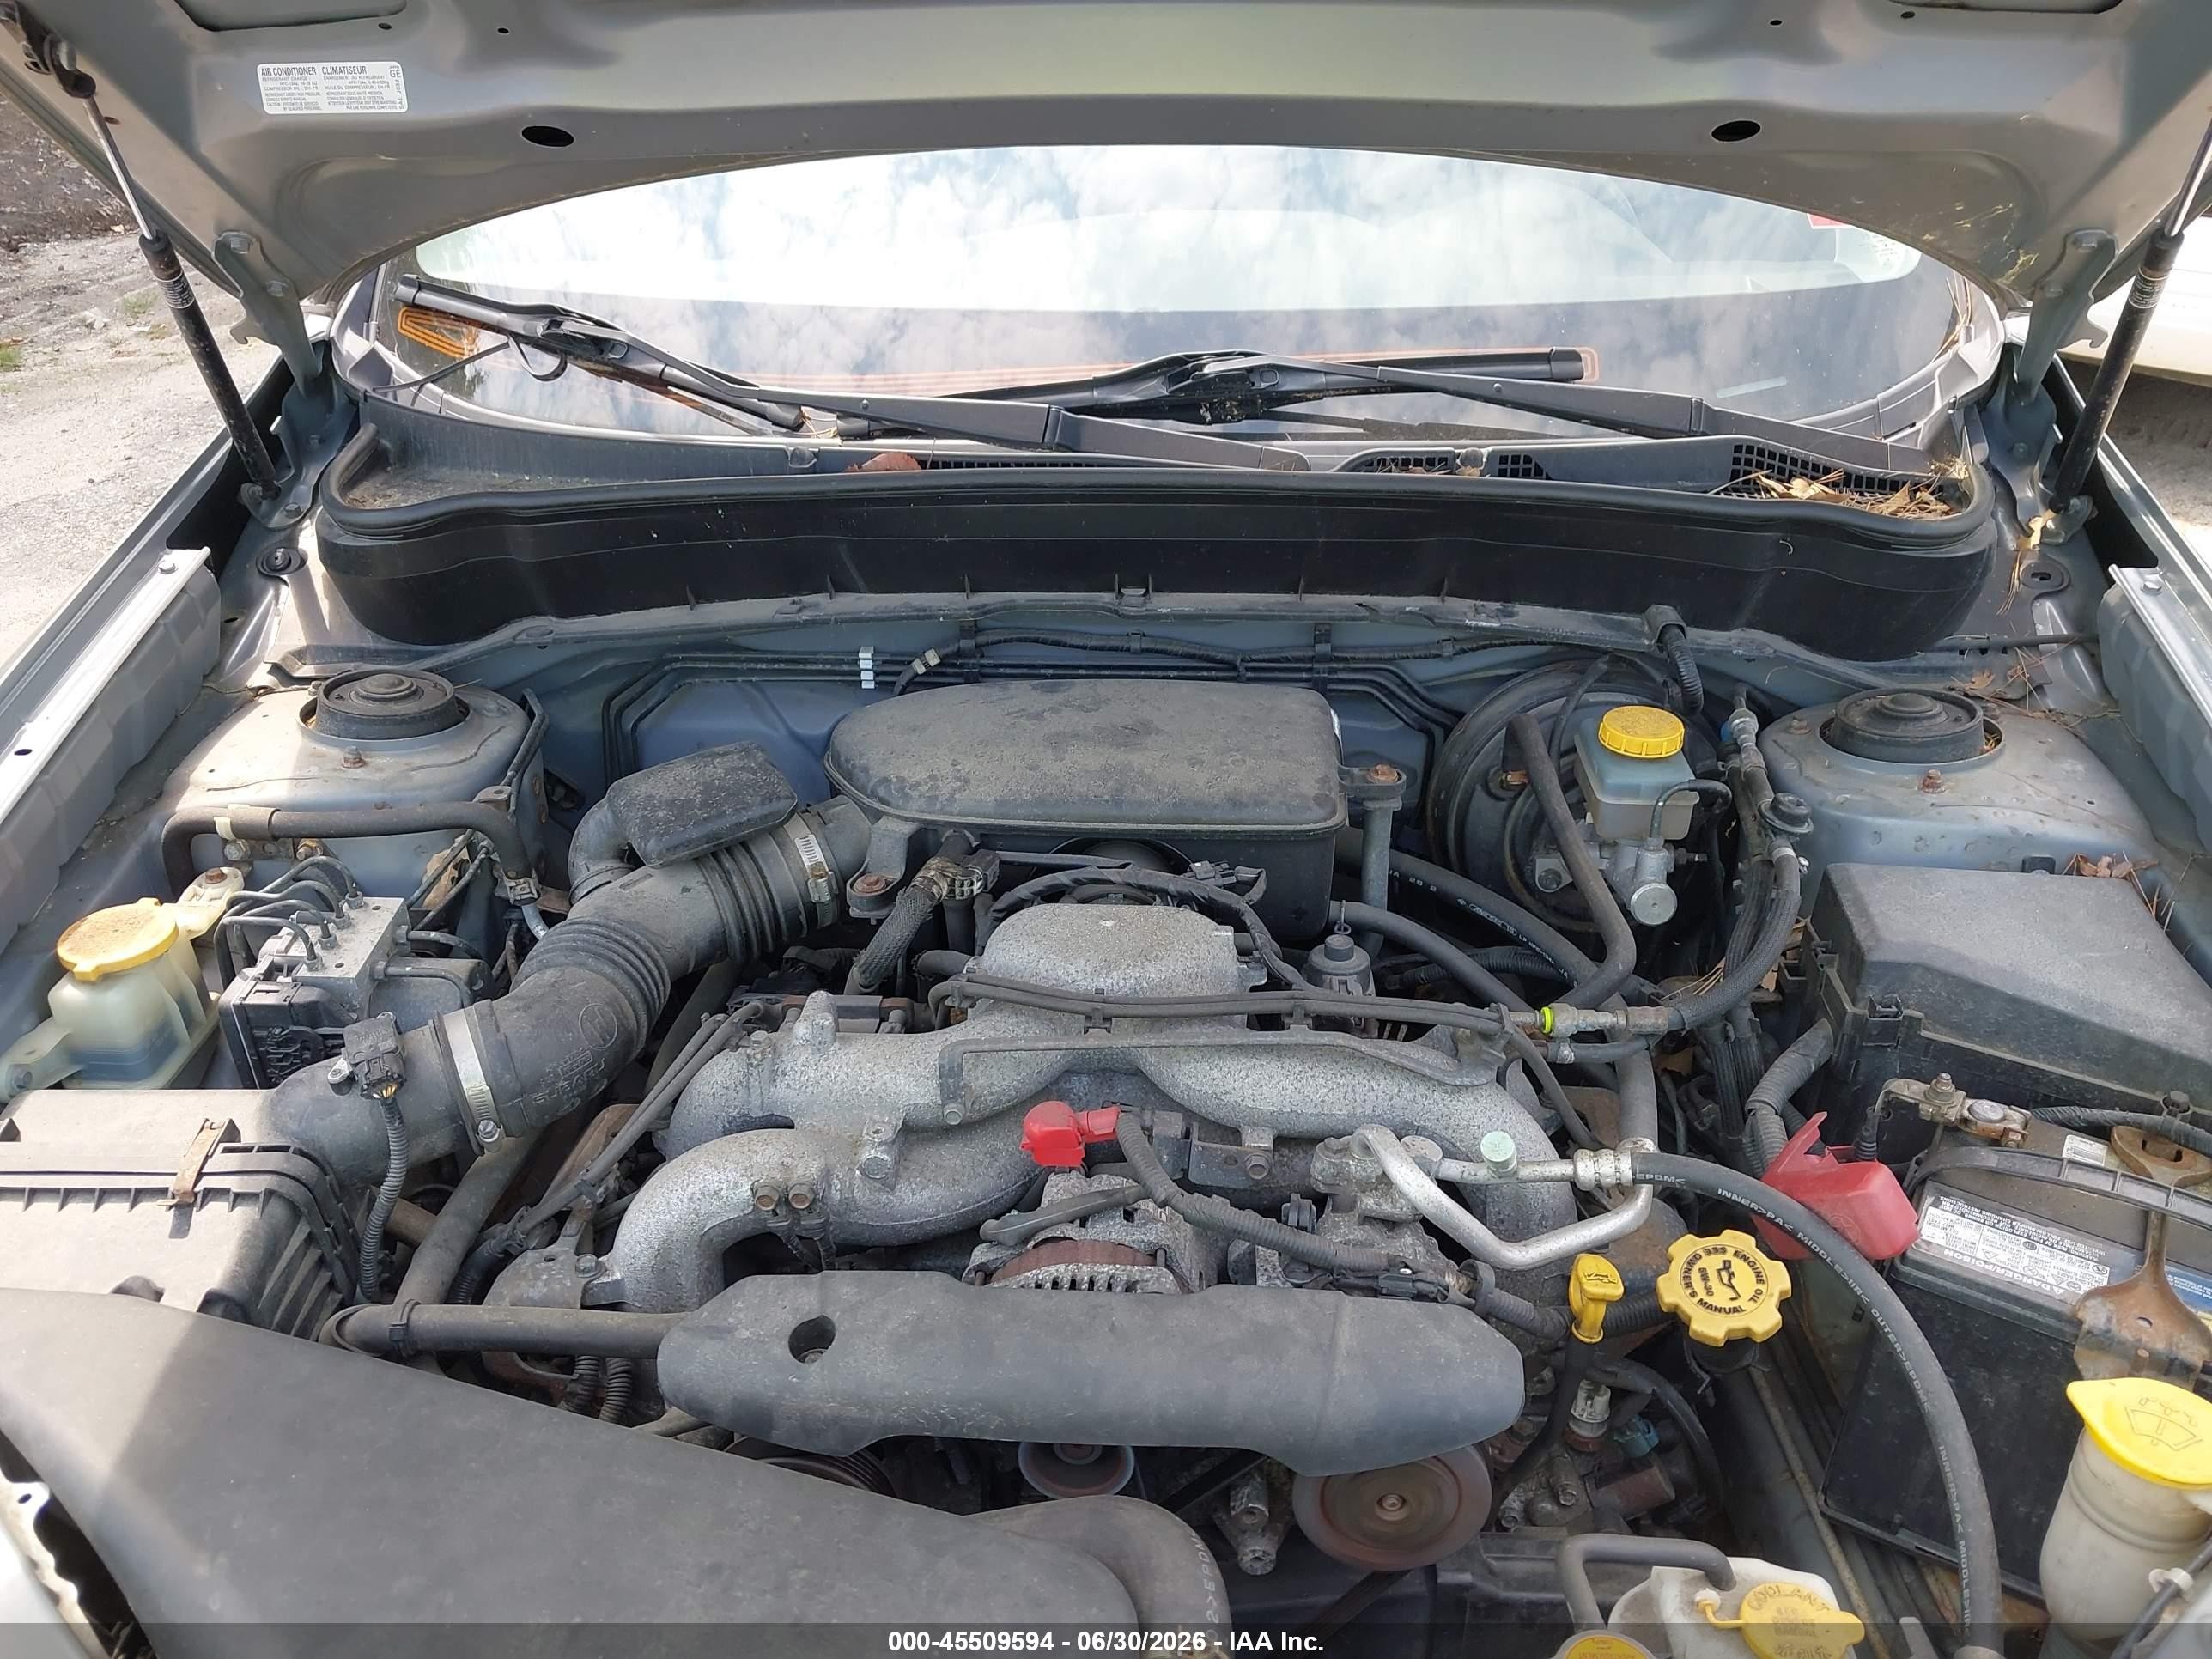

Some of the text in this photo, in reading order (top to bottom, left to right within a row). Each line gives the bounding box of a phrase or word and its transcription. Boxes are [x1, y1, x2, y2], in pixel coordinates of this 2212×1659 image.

[273, 67, 316, 76] CONDITIONER
[322, 66, 367, 75] CLIMATISEUR
[389, 70, 401, 78] GE
[1682, 1246, 1747, 1314] SEE OWNER'S MANUAL
[1733, 1249, 1765, 1304] ENGINE OIL
[1941, 1247, 2053, 1291] DANGER/POISON
